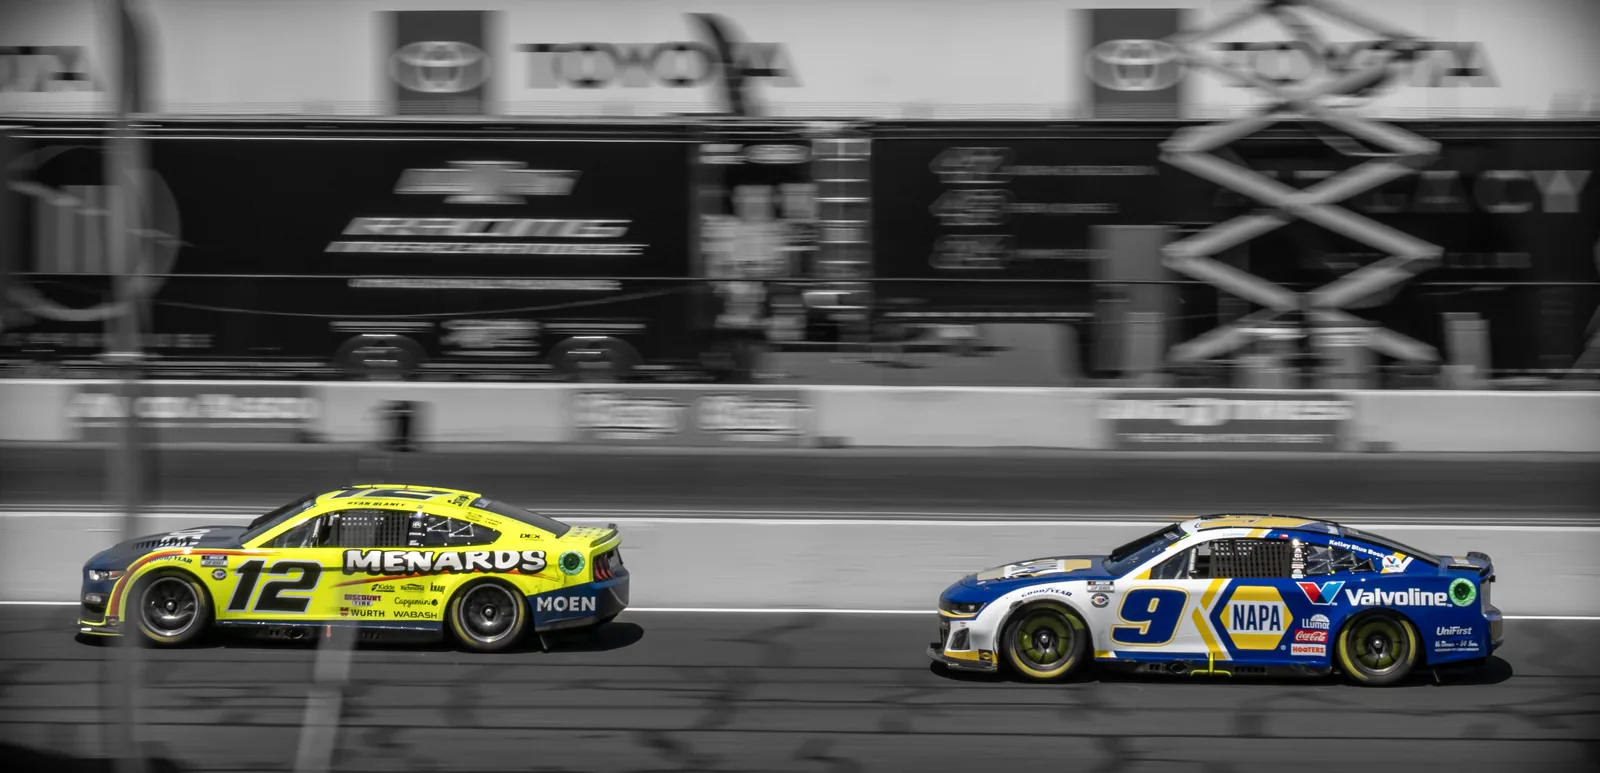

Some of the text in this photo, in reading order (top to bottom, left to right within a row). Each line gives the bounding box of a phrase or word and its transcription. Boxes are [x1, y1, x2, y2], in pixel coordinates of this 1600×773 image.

[517, 41, 804, 88] TOYOA
[519, 532, 541, 540] DEX
[1328, 538, 1386, 559] Kelley Blue Book
[342, 548, 548, 575] MENARDS
[227, 557, 324, 615] 12
[344, 594, 382, 602] DISCOUNT
[394, 596, 431, 608] Capgemini
[536, 596, 597, 612] MOEN
[1345, 588, 1448, 607] Valvoline
[393, 611, 438, 619] WABASH
[1110, 585, 1190, 647] 9
[1232, 604, 1282, 631] NAPA
[1436, 626, 1473, 636] UniFirst
[1292, 646, 1325, 654] HOOTERS
